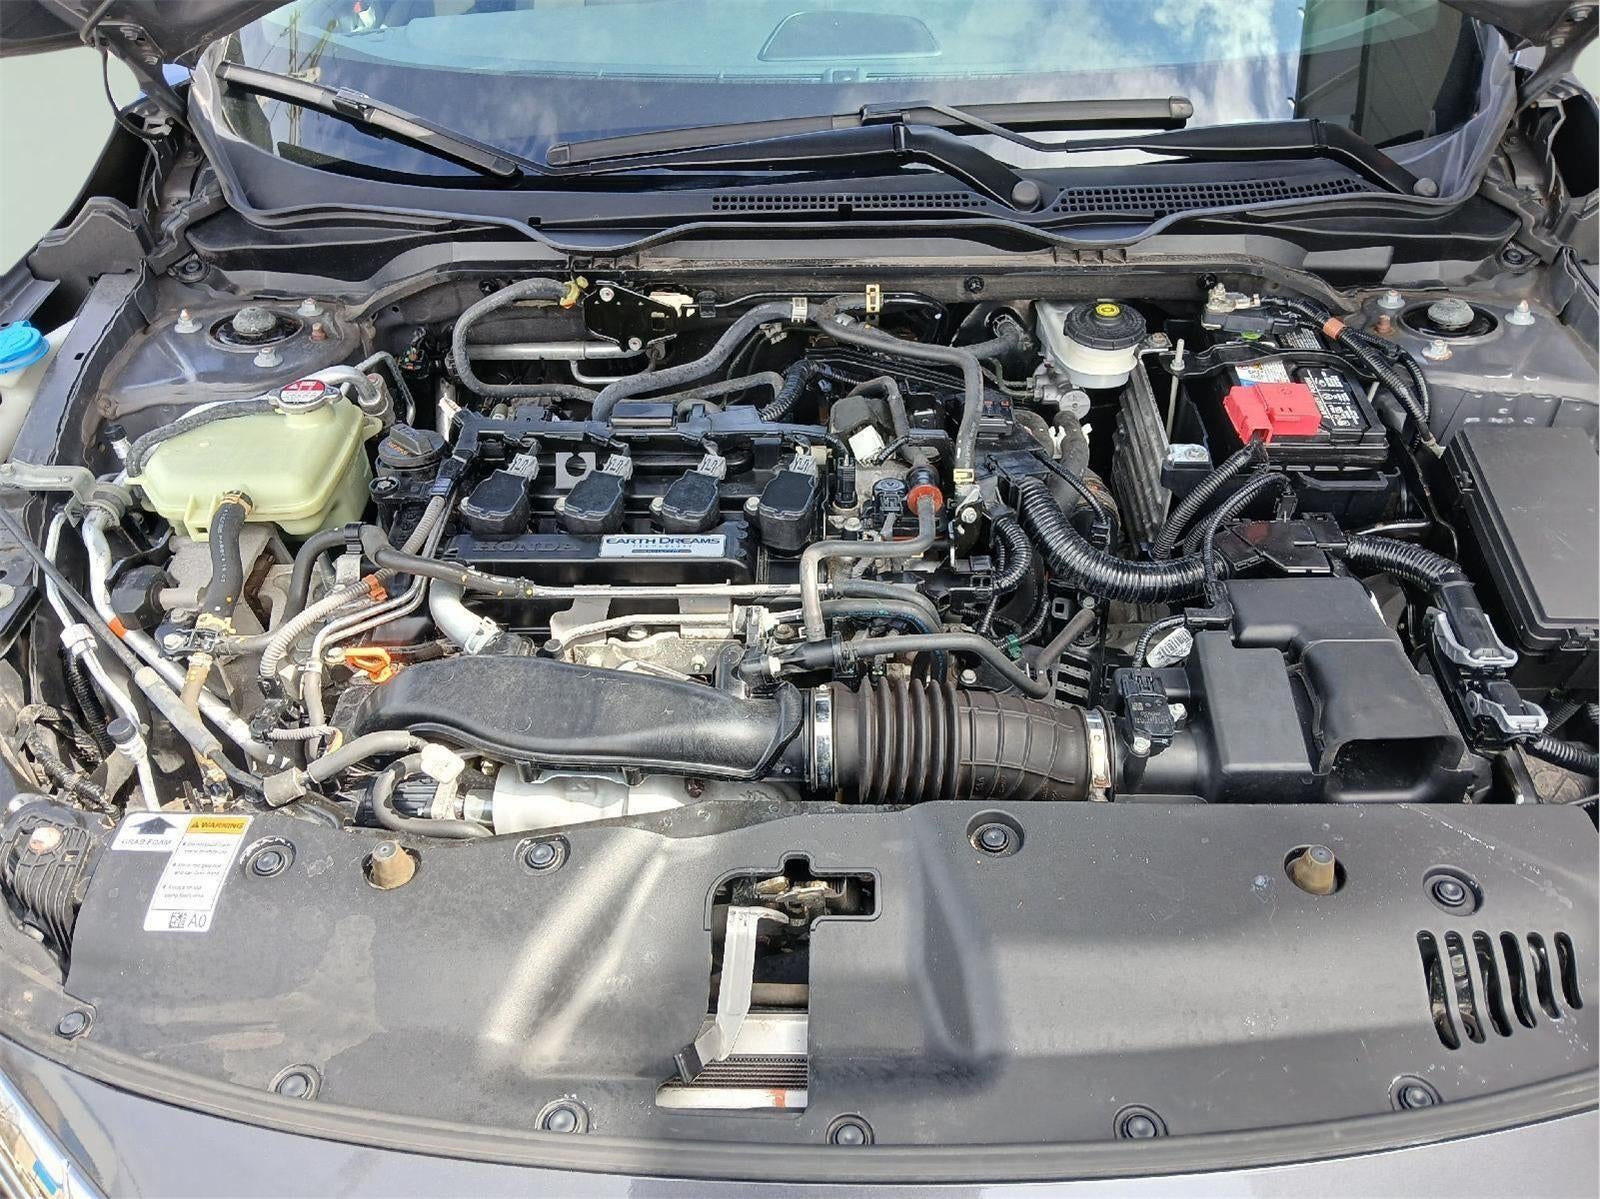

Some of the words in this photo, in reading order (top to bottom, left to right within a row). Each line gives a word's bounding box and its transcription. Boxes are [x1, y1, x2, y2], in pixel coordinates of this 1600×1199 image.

[606, 537, 656, 545] EARTH
[659, 536, 720, 545] DREAMS
[472, 540, 581, 552] HONDA
